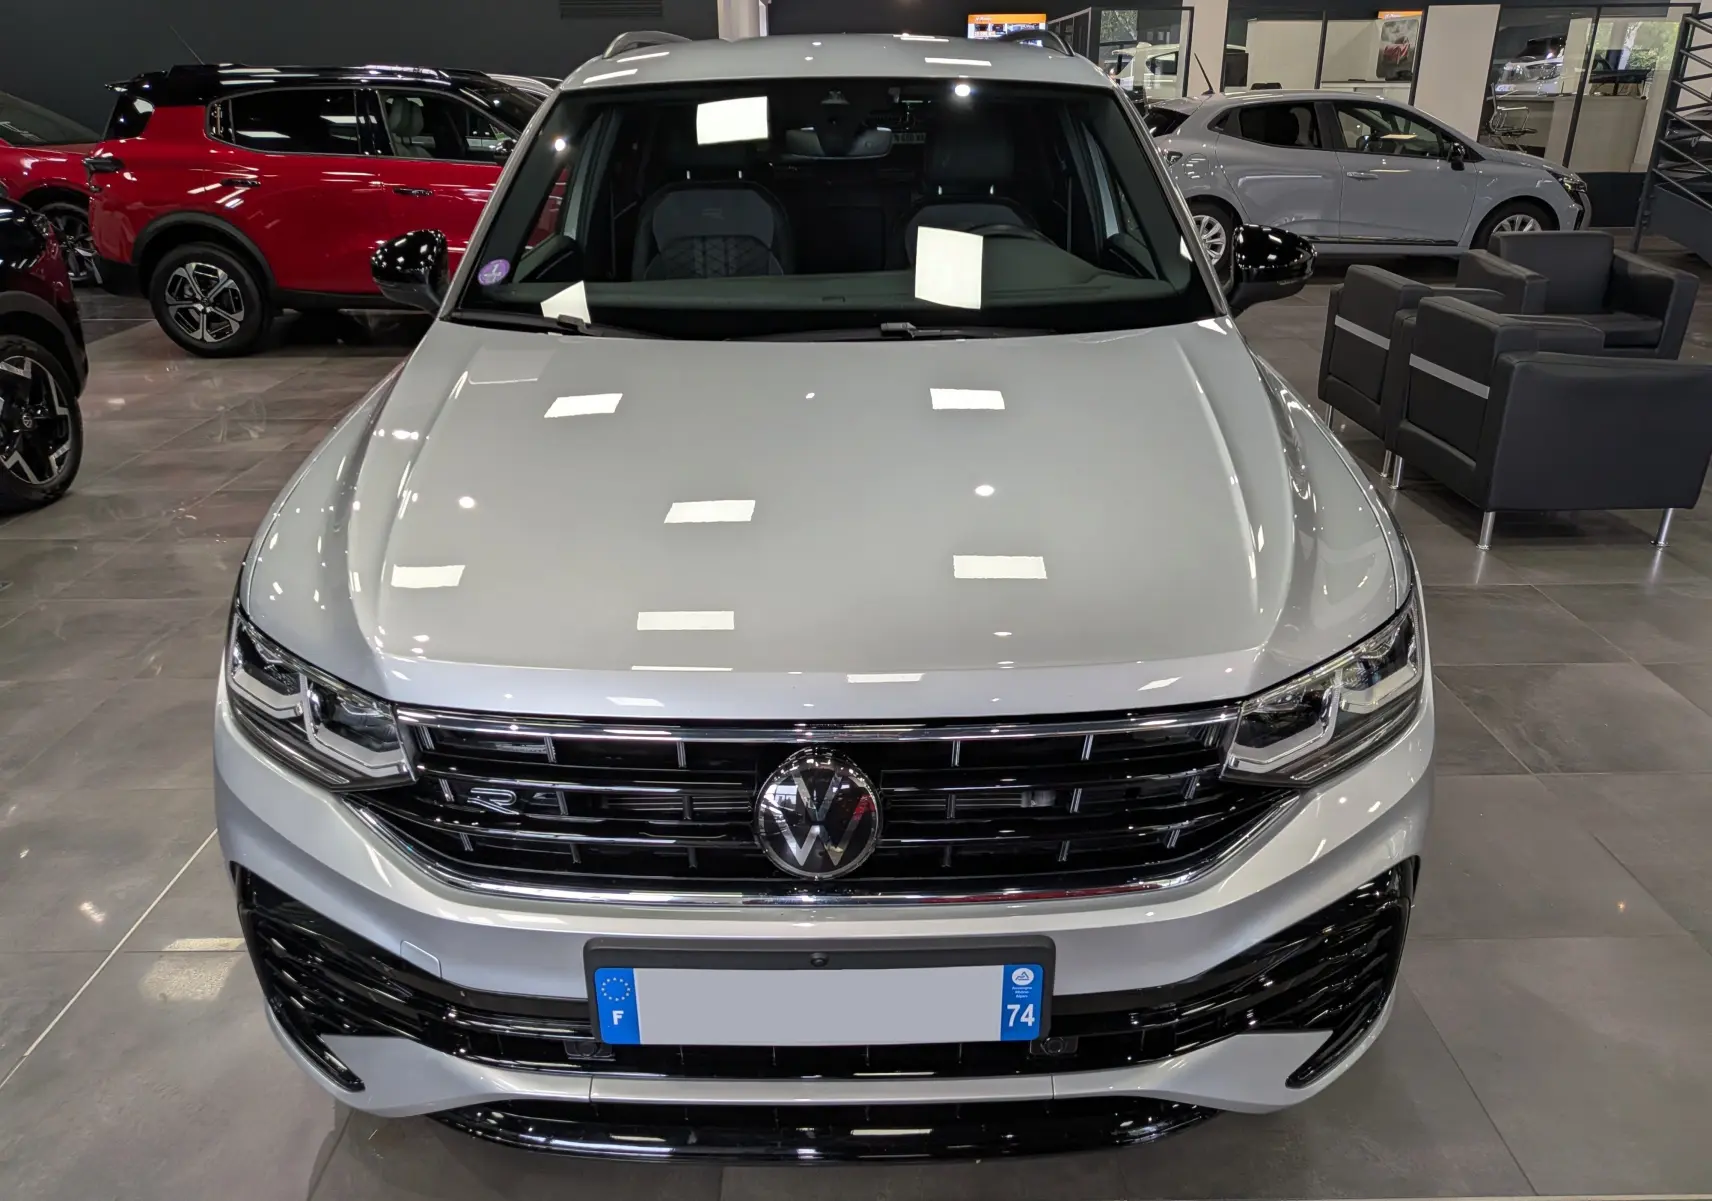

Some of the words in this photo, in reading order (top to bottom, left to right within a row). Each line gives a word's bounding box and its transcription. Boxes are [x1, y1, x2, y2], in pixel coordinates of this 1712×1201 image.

[467, 787, 520, 815] R
[612, 1010, 624, 1025] F
[1006, 1003, 1036, 1028] 74
